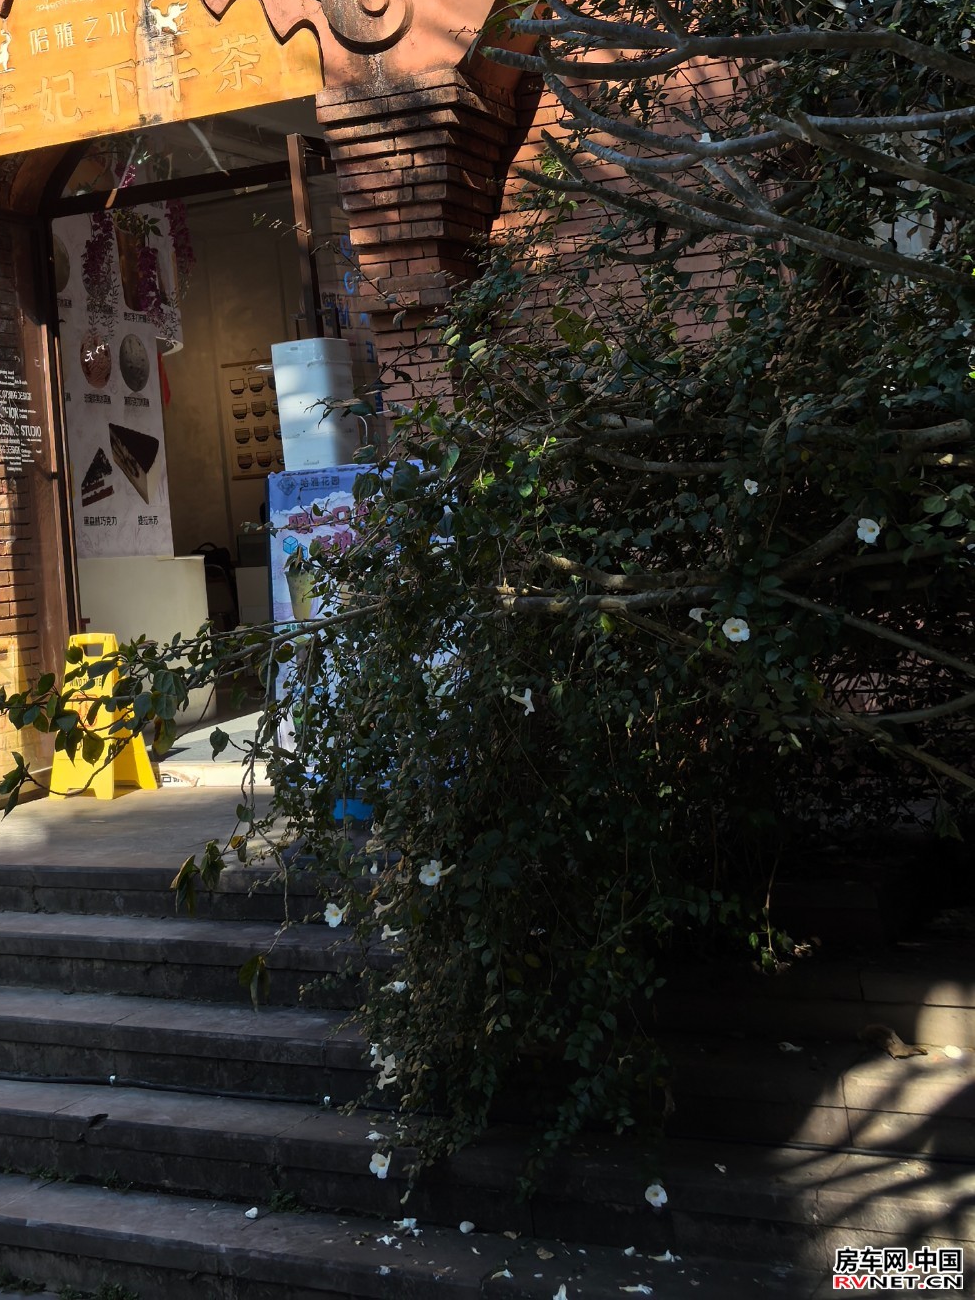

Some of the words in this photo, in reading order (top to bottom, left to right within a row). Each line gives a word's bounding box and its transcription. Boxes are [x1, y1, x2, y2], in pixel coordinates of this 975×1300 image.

[29, 9, 129, 55] 哈雅之水
[20, 424, 42, 438] STUDIO
